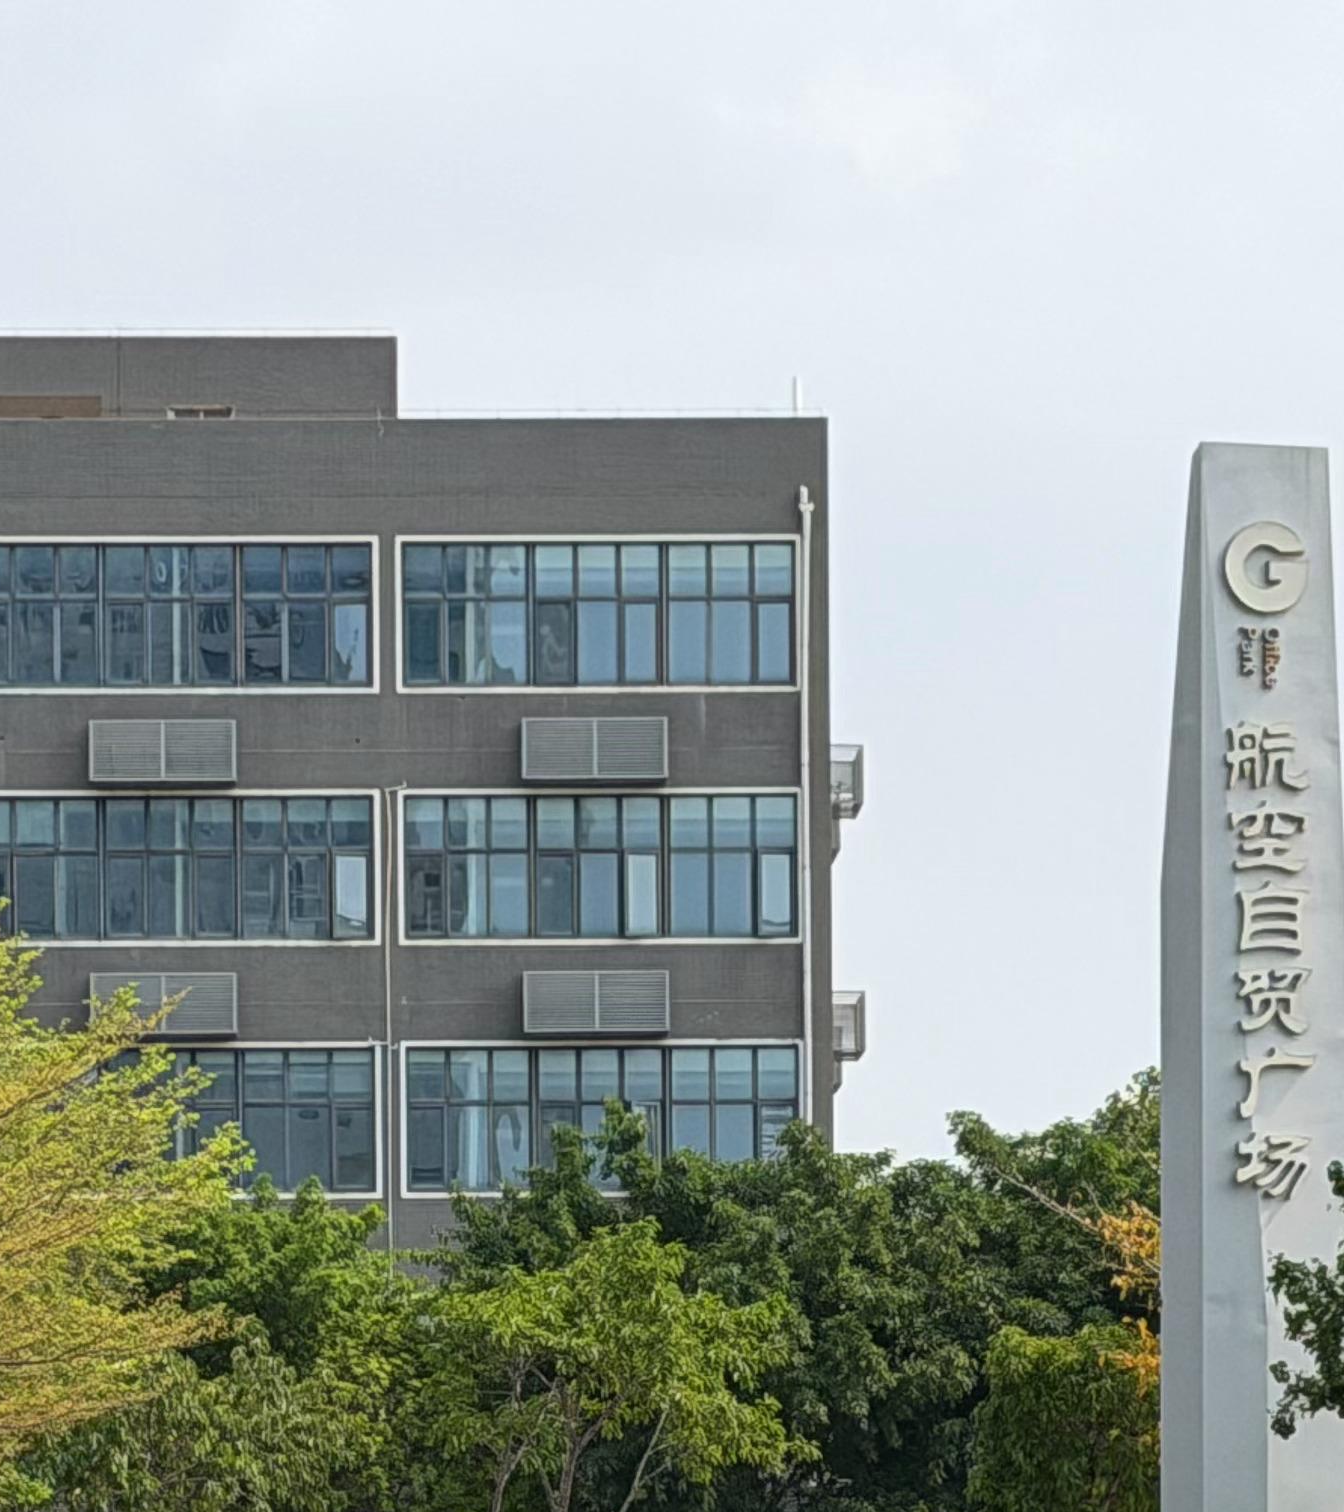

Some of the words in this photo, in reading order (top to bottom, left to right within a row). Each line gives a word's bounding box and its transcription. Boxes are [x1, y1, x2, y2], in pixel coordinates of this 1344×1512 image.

[1223, 720, 1317, 1203] 航空自贸广场
